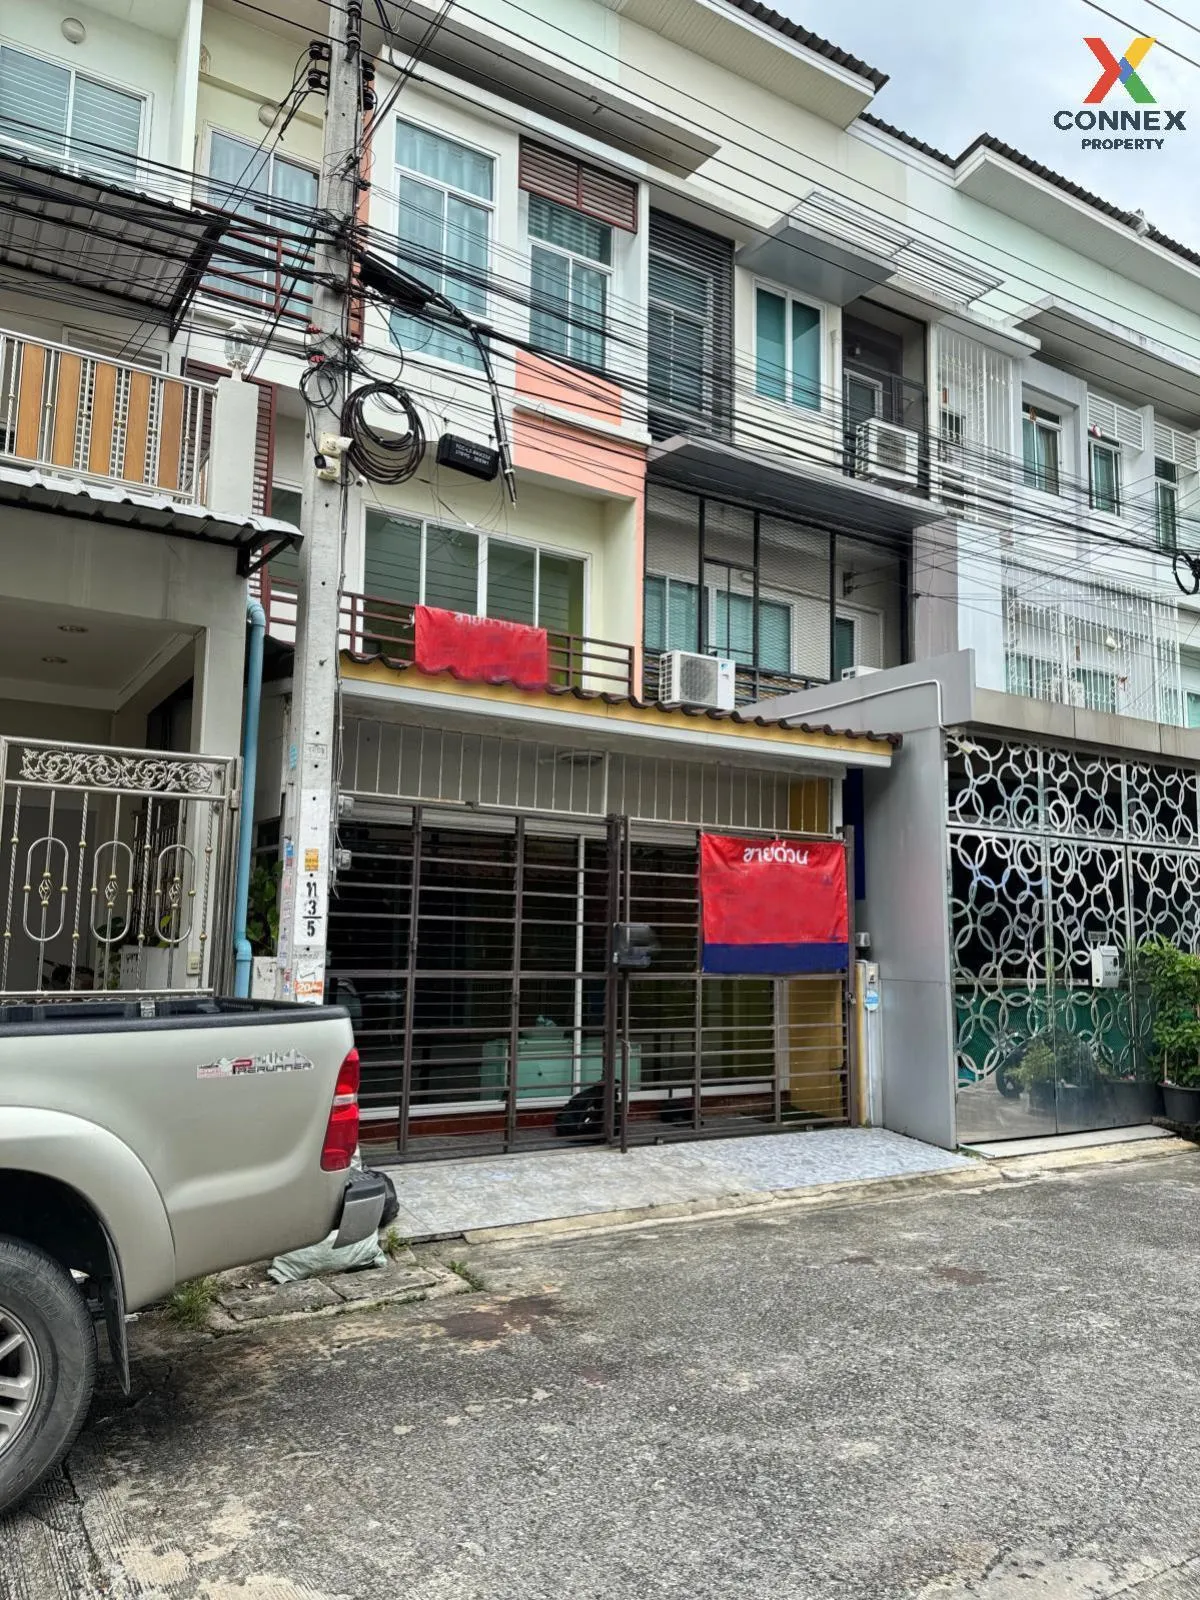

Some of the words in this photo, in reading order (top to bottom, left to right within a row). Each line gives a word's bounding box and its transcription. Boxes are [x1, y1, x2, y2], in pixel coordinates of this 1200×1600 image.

[743, 840, 809, 865] ขายด่วน
[307, 899, 317, 915] 3
[306, 920, 316, 937] 5
